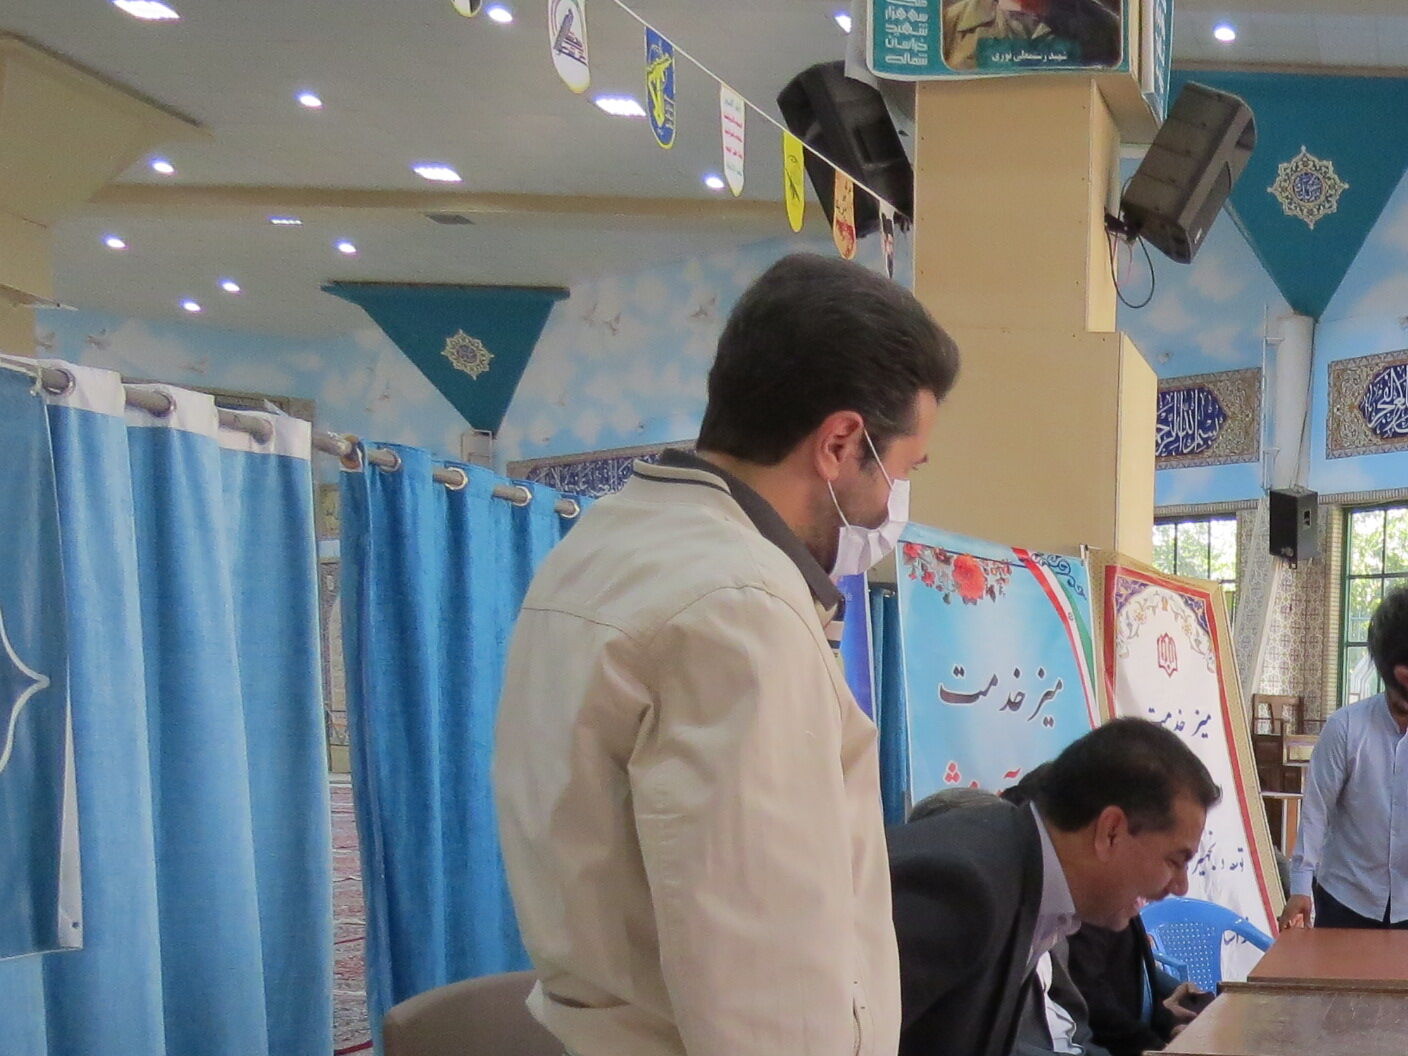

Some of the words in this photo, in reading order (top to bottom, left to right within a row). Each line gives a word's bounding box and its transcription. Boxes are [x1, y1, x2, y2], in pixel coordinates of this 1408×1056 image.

[885, 22, 928, 36] شهید
[885, 35, 928, 51] خراسان
[939, 665, 1026, 711] خدمت
[1028, 667, 1063, 727] میز
[1191, 709, 1212, 739] میز
